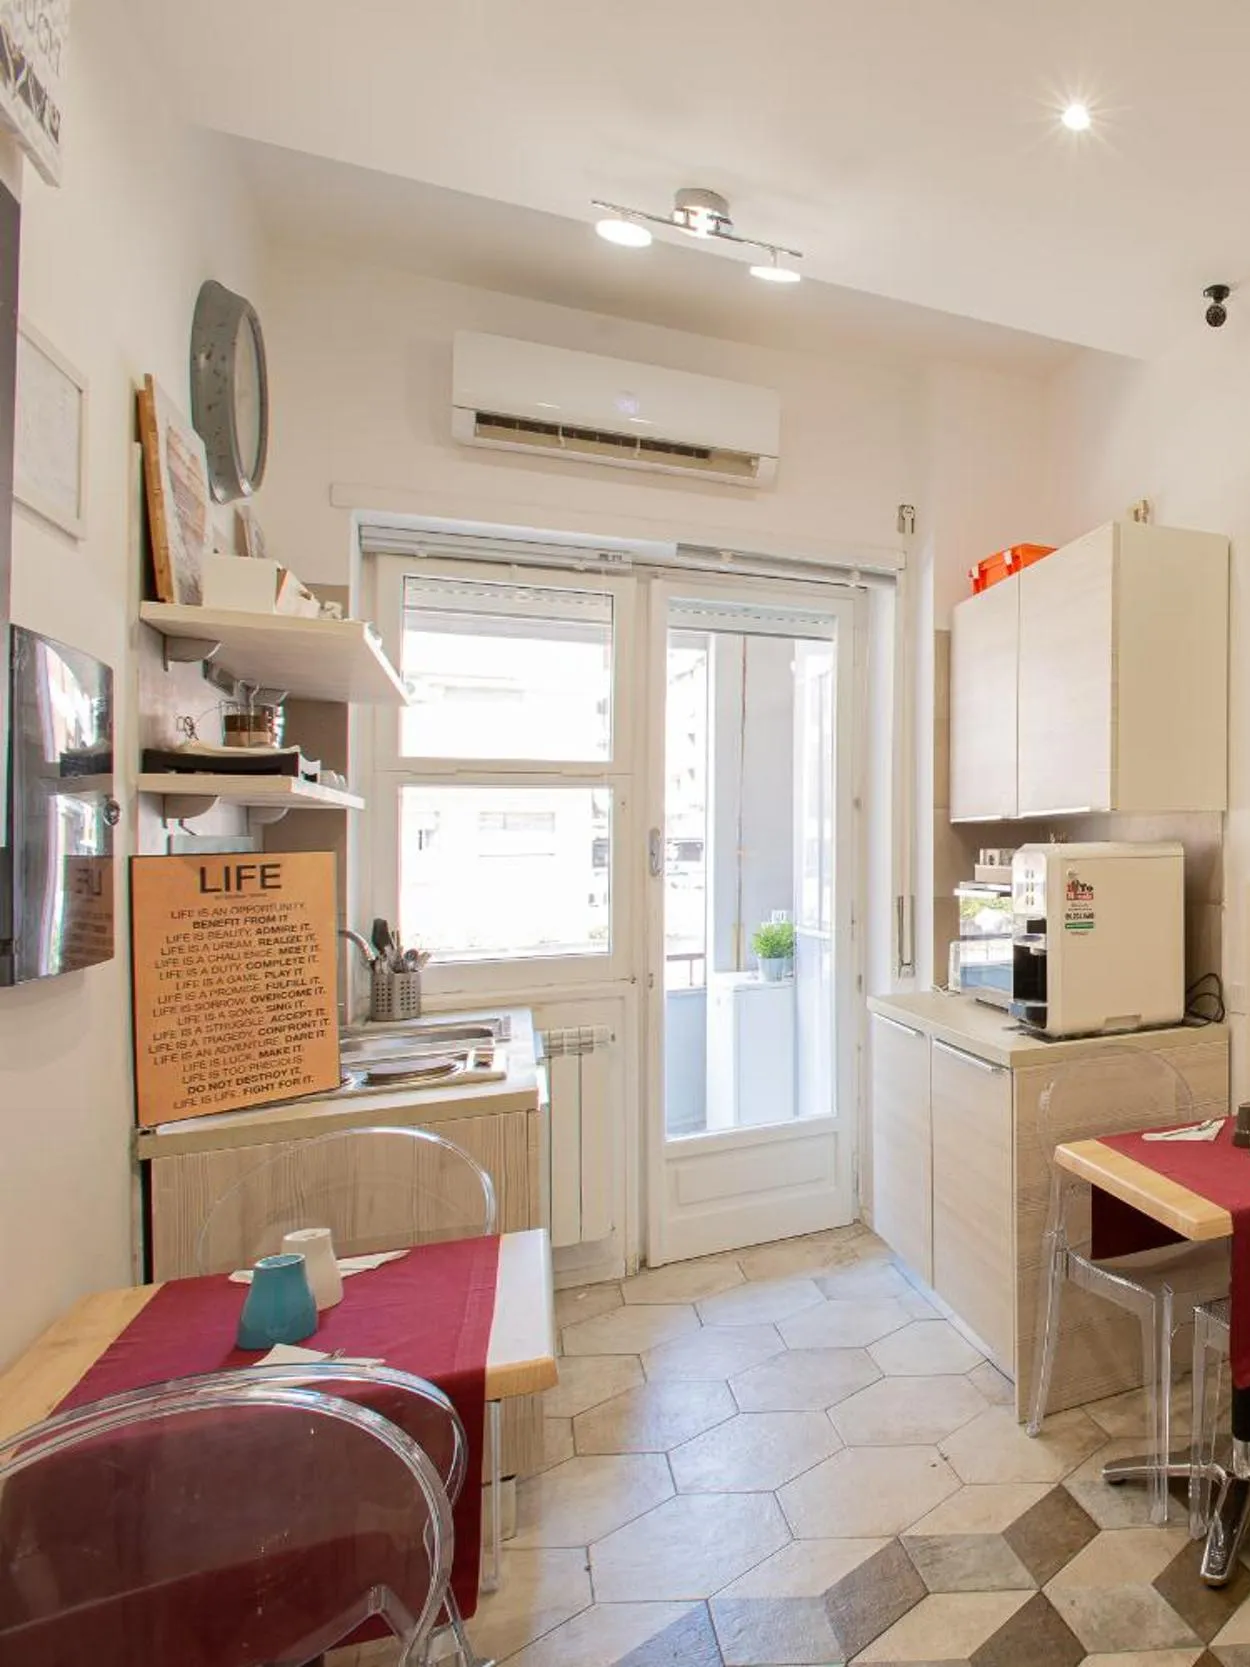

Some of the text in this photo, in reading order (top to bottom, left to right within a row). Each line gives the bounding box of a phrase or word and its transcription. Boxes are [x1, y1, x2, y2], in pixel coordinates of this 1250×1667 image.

[200, 863, 282, 894] LIFE
[170, 909, 194, 920] LIFE
[198, 907, 209, 918] IS
[192, 914, 276, 929] BENEFIT FROM
[160, 934, 304, 956] LIFE REALIZE
[166, 932, 191, 945] LIFE
[256, 924, 297, 936] ADMIRE
[154, 957, 180, 969] LIFE
[278, 944, 307, 955] MEET
[159, 969, 182, 981] LIFE
[245, 956, 305, 971] COMPLETE
[157, 992, 182, 1005] LIFE
[265, 978, 307, 991] FULFILL
[176, 969, 290, 991] LIFE PLAY
[152, 1005, 176, 1018] LIFE
[250, 988, 313, 1004] OVERCOME
[177, 1003, 292, 1026] LIFE SING
[148, 1041, 174, 1054] LIFE
[258, 1020, 317, 1036] CONFRONT
[152, 1009, 313, 1041] LIFE ACCEPT
[153, 1031, 314, 1066] LIFE DARE
[182, 1060, 208, 1073] LIFE
[258, 1046, 291, 1059] MAKE
[182, 1072, 207, 1085] LIFE
[188, 1068, 288, 1095] DO NOT DESTROY
[173, 1097, 198, 1110] LIFE
[243, 1083, 275, 1095] FIGHT
[278, 1077, 301, 1089] FOR
